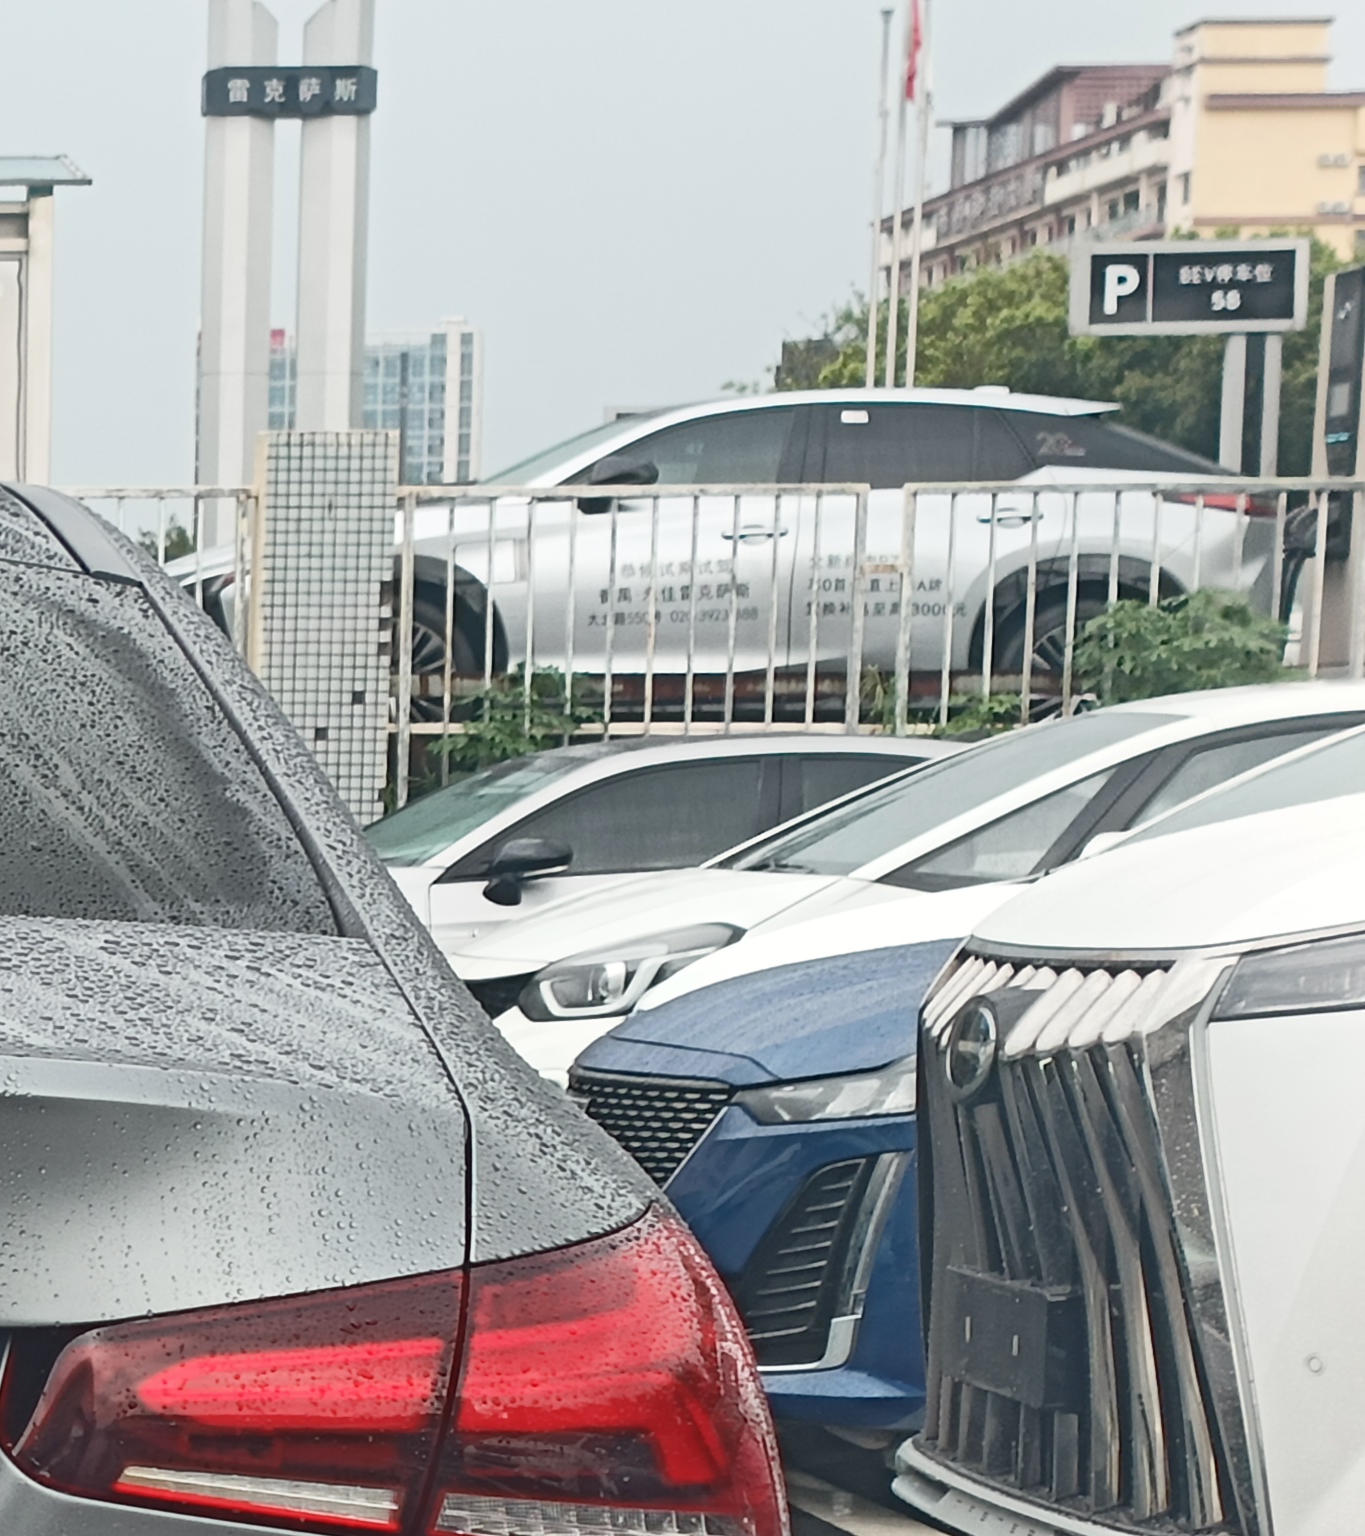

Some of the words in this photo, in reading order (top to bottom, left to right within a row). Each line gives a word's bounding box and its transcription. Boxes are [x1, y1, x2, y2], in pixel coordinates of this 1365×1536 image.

[227, 78, 357, 103] 雷克萨斯
[1103, 264, 1140, 315] P
